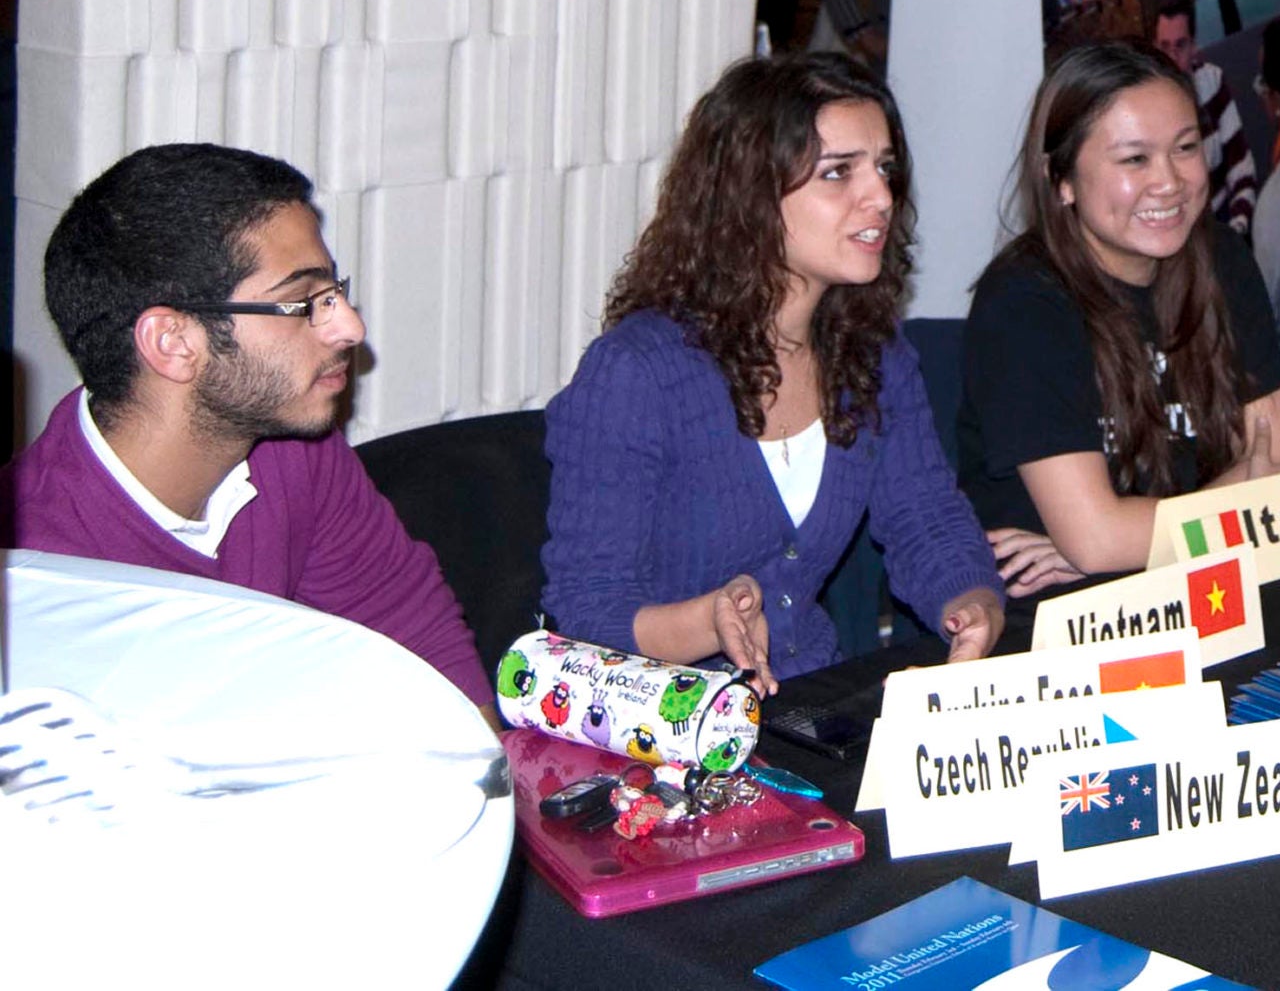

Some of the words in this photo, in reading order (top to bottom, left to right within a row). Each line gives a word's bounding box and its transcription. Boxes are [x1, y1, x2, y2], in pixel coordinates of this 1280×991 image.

[560, 656, 604, 687] Wacky
[605, 669, 660, 696] Woollies
[916, 738, 991, 799] Czech
[1165, 760, 1224, 830] New
[840, 957, 896, 985] Model
[892, 937, 948, 963] United
[941, 914, 1003, 943] Nations
[858, 970, 905, 991] 2011
